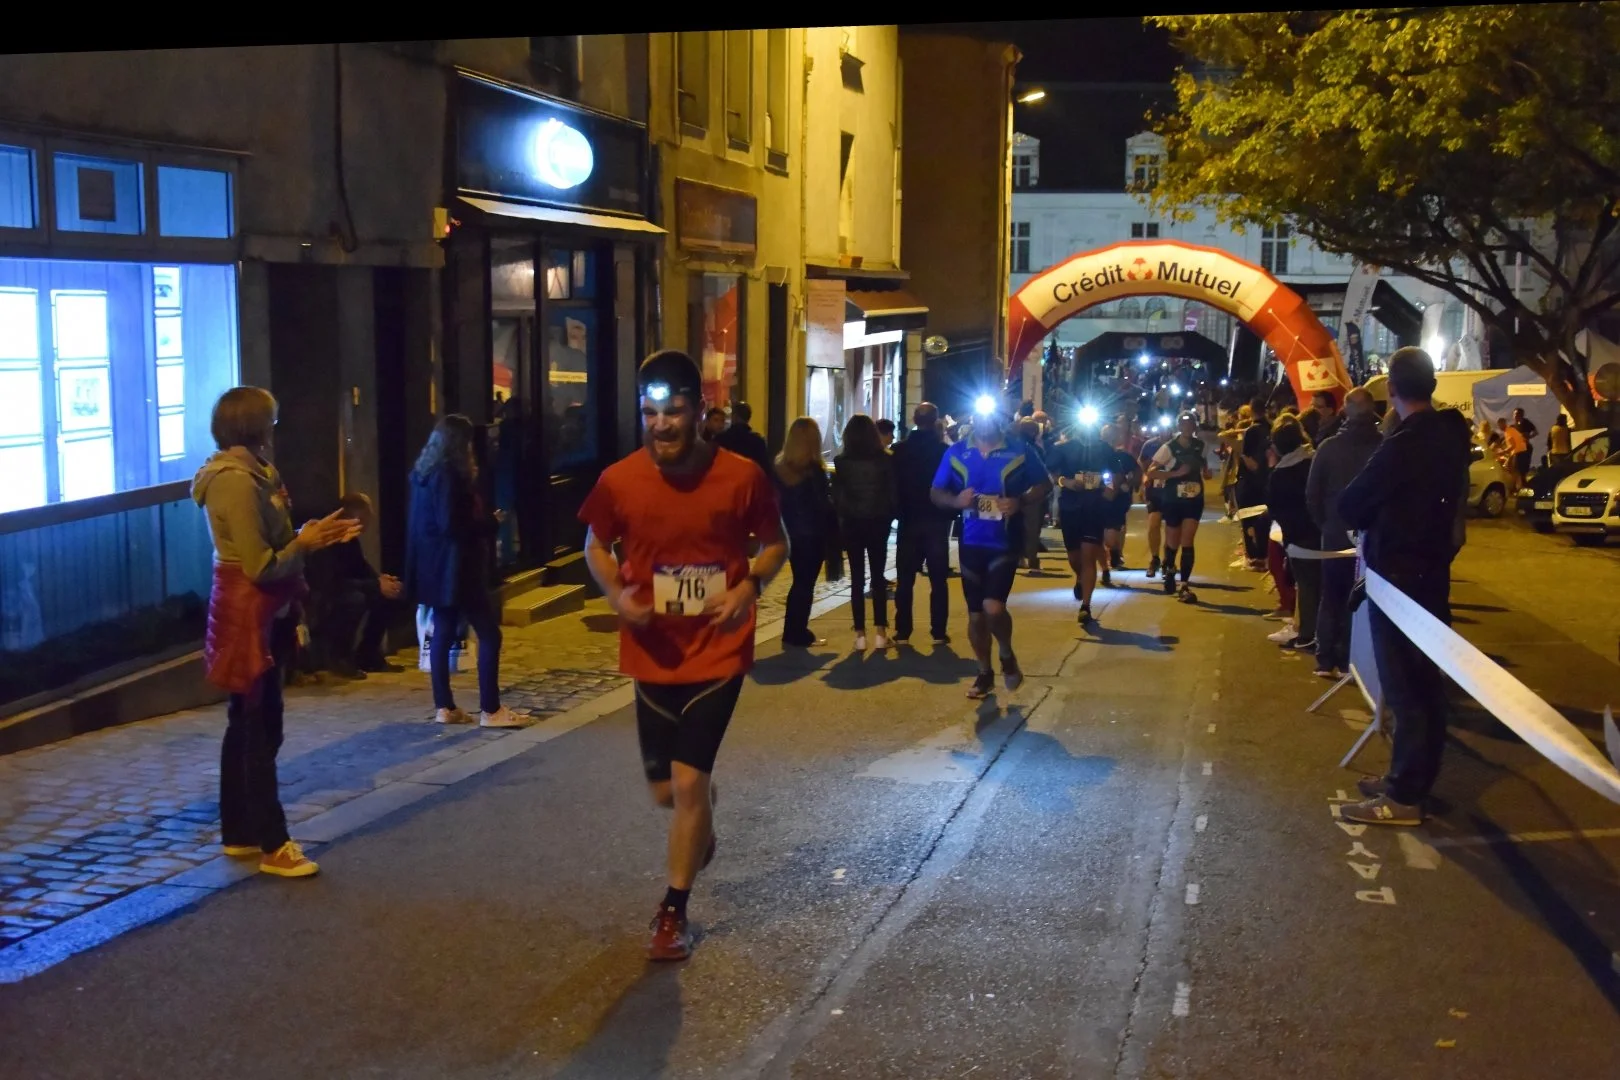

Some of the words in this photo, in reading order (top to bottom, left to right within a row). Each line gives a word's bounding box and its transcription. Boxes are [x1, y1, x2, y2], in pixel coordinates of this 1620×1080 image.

[1053, 264, 1125, 304] Crédit
[1157, 261, 1241, 300] Mutuel
[675, 577, 705, 600] 716
